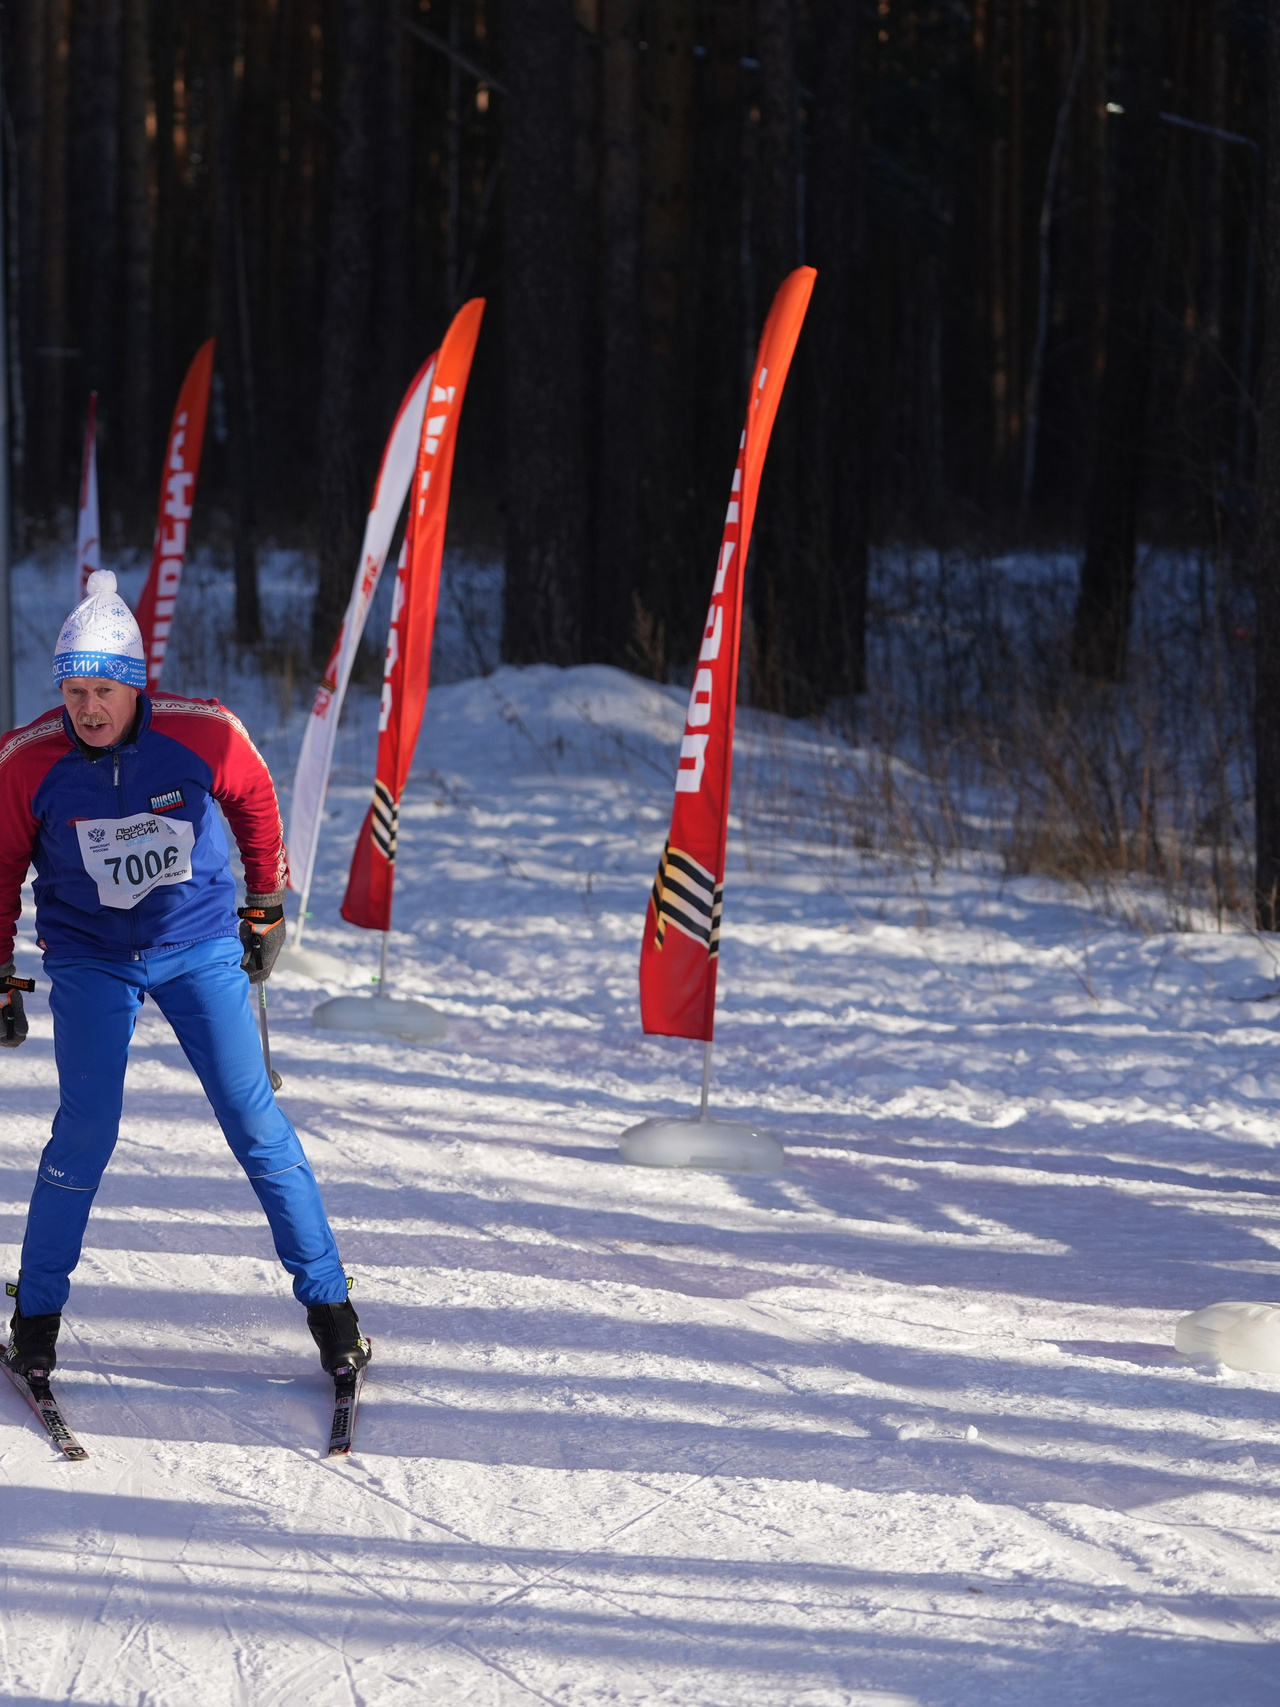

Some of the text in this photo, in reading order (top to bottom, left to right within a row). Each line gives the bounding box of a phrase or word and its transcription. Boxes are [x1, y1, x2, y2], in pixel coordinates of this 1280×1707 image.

[151, 790, 183, 811] RUSSIA
[115, 826, 160, 841] РОССИИ
[116, 819, 157, 835] ЛЫЖНЯ
[125, 834, 154, 847] 2025
[104, 845, 179, 886] 7006
[164, 869, 188, 879] ОБЛАСТЬ
